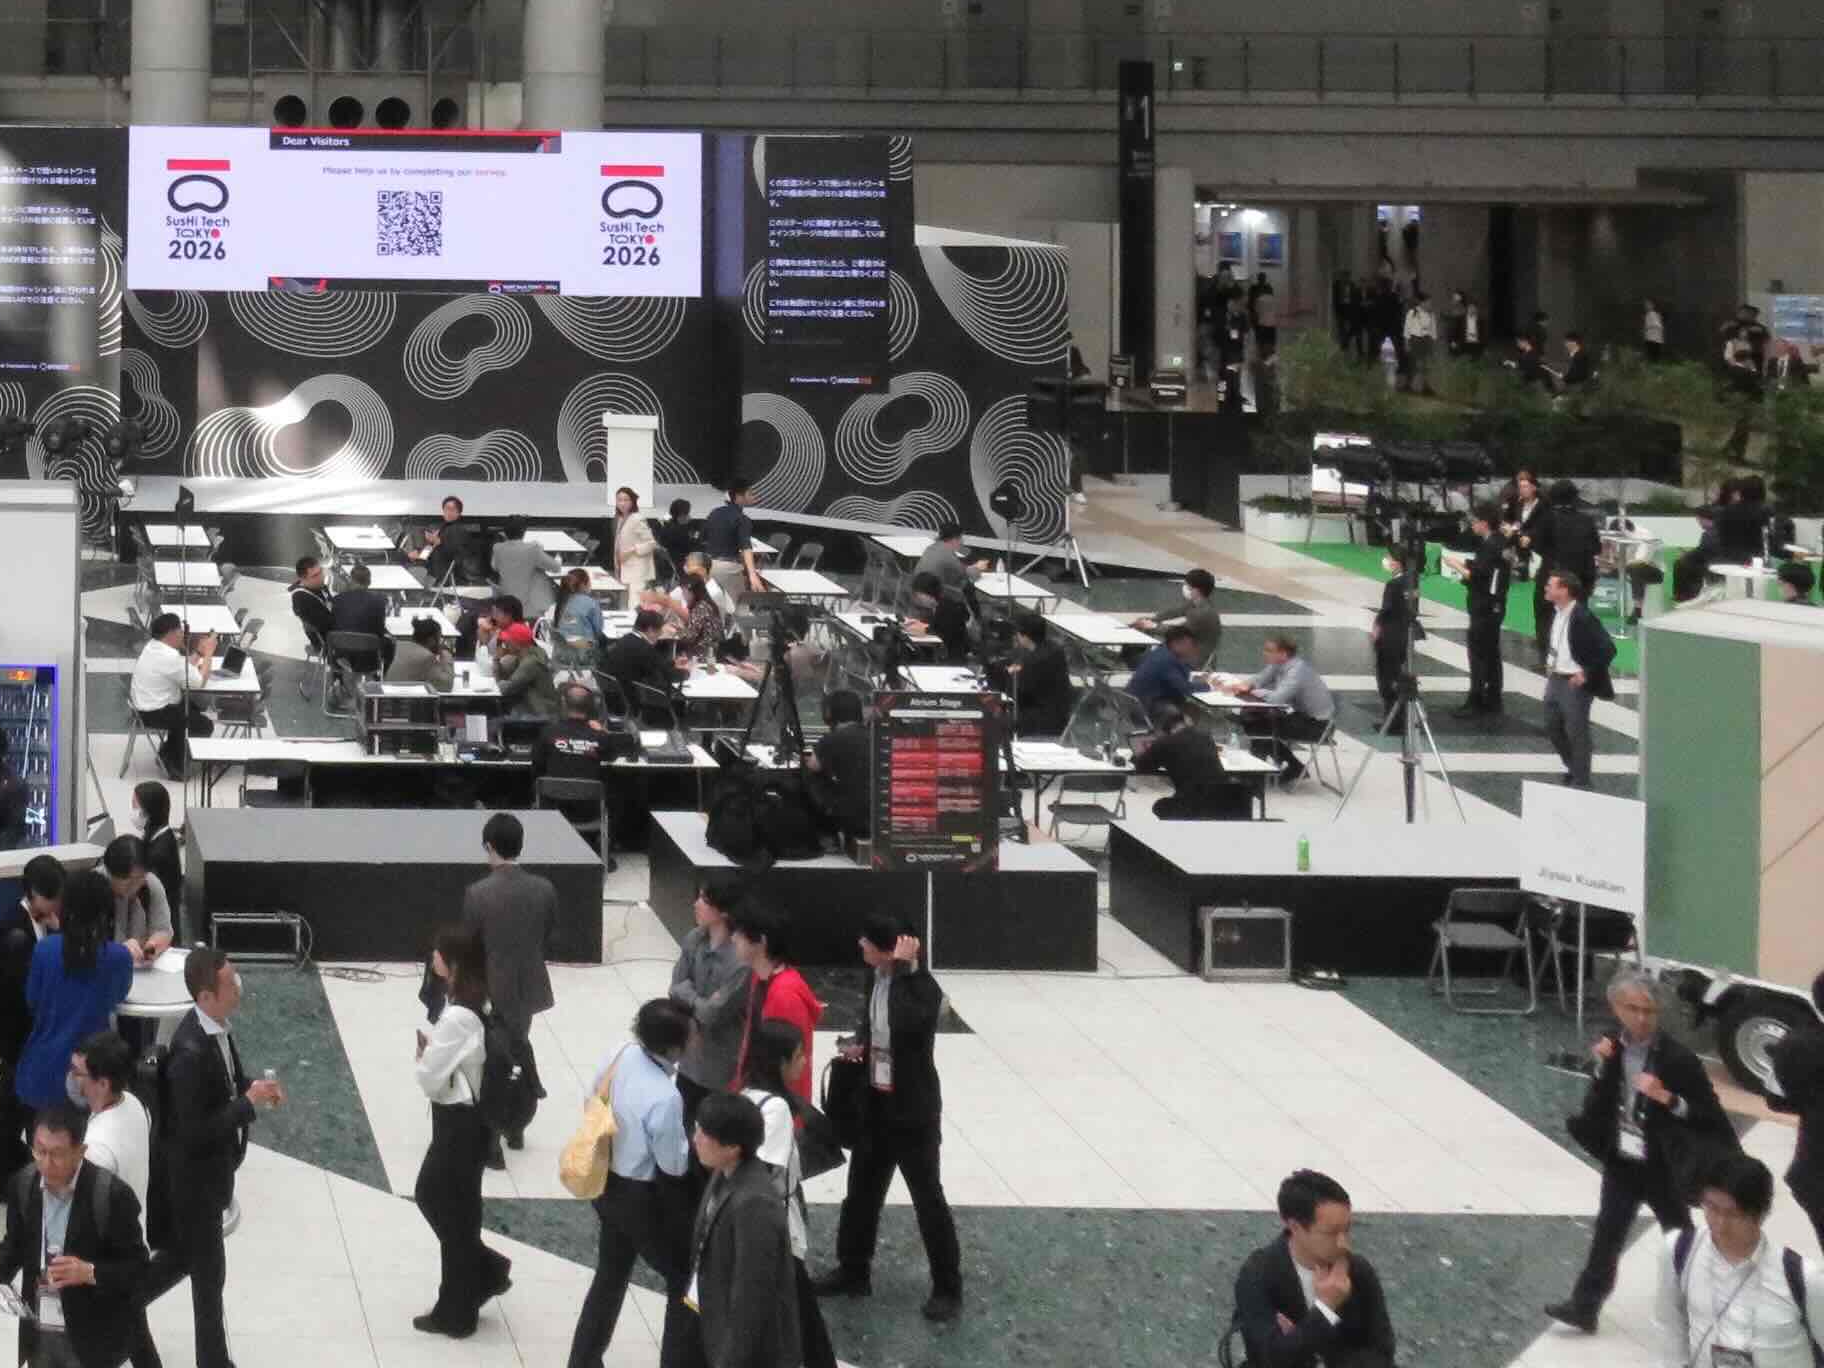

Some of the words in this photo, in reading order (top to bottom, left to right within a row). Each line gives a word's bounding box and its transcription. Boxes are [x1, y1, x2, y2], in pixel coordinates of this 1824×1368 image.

[283, 136, 307, 145] Dear
[310, 136, 350, 147] Visitors
[166, 215, 198, 227] SusHi
[201, 215, 230, 228] Tech
[600, 221, 630, 233] SusHi
[635, 221, 665, 233] Tech
[168, 240, 226, 260] 2026
[602, 246, 661, 266] 2026
